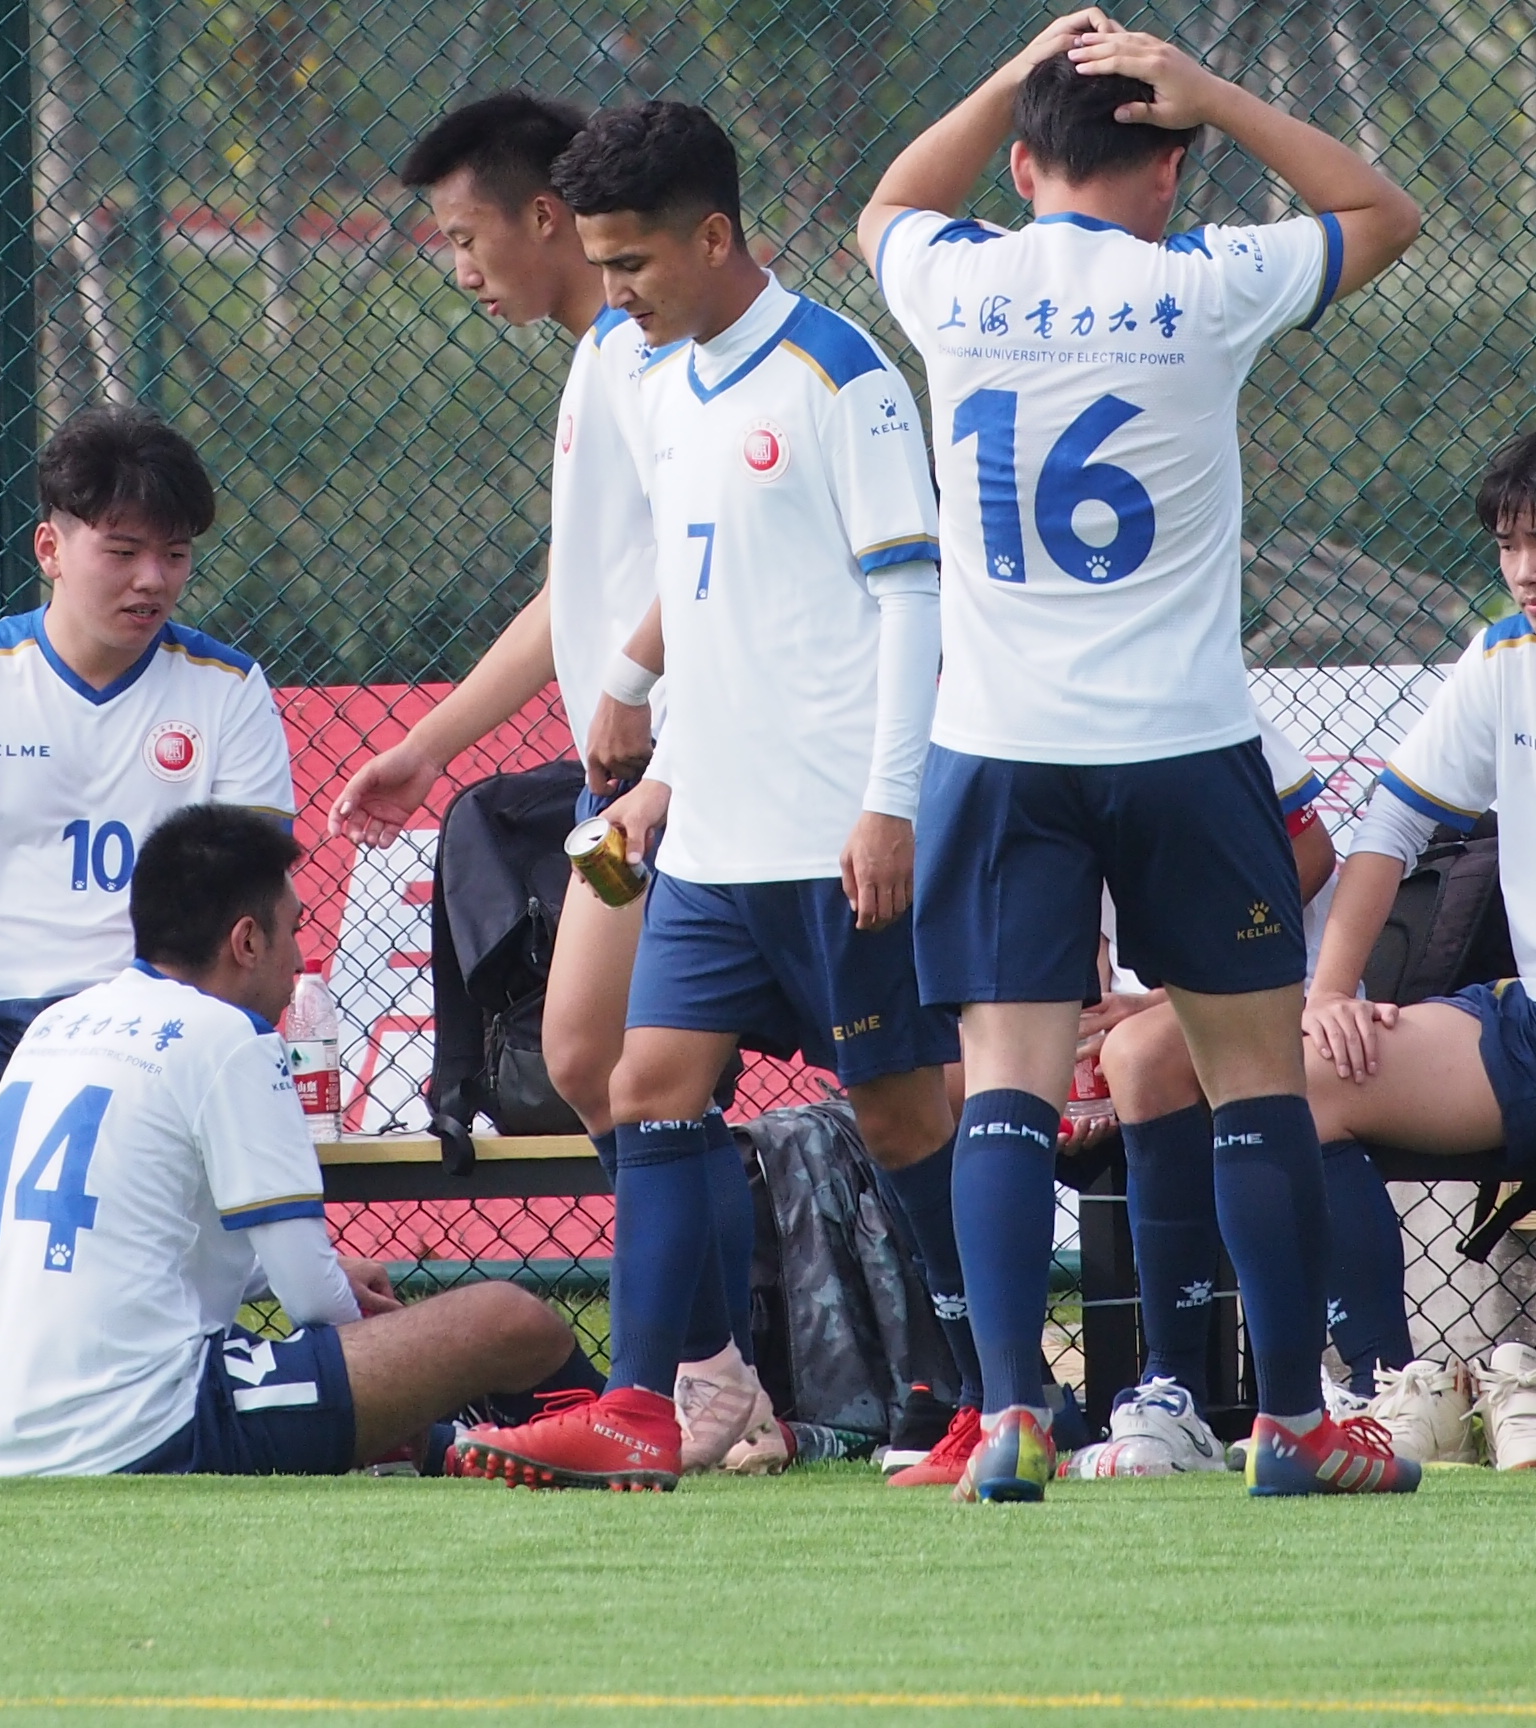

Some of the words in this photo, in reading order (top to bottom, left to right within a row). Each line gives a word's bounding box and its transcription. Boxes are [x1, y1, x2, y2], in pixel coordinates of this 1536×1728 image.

[985, 348, 1056, 363] UNIVERSITY
[1058, 351, 1074, 363] OF
[1077, 351, 1136, 364] ELECTRIC
[1139, 352, 1186, 365] POWER
[951, 387, 1156, 585] 16
[687, 522, 716, 600] 7
[61, 818, 136, 893] 10
[1236, 922, 1282, 942] KELME
[124, 1055, 163, 1076] POWER
[968, 1122, 1051, 1150] KELME
[593, 1423, 662, 1458] NEMESIS
